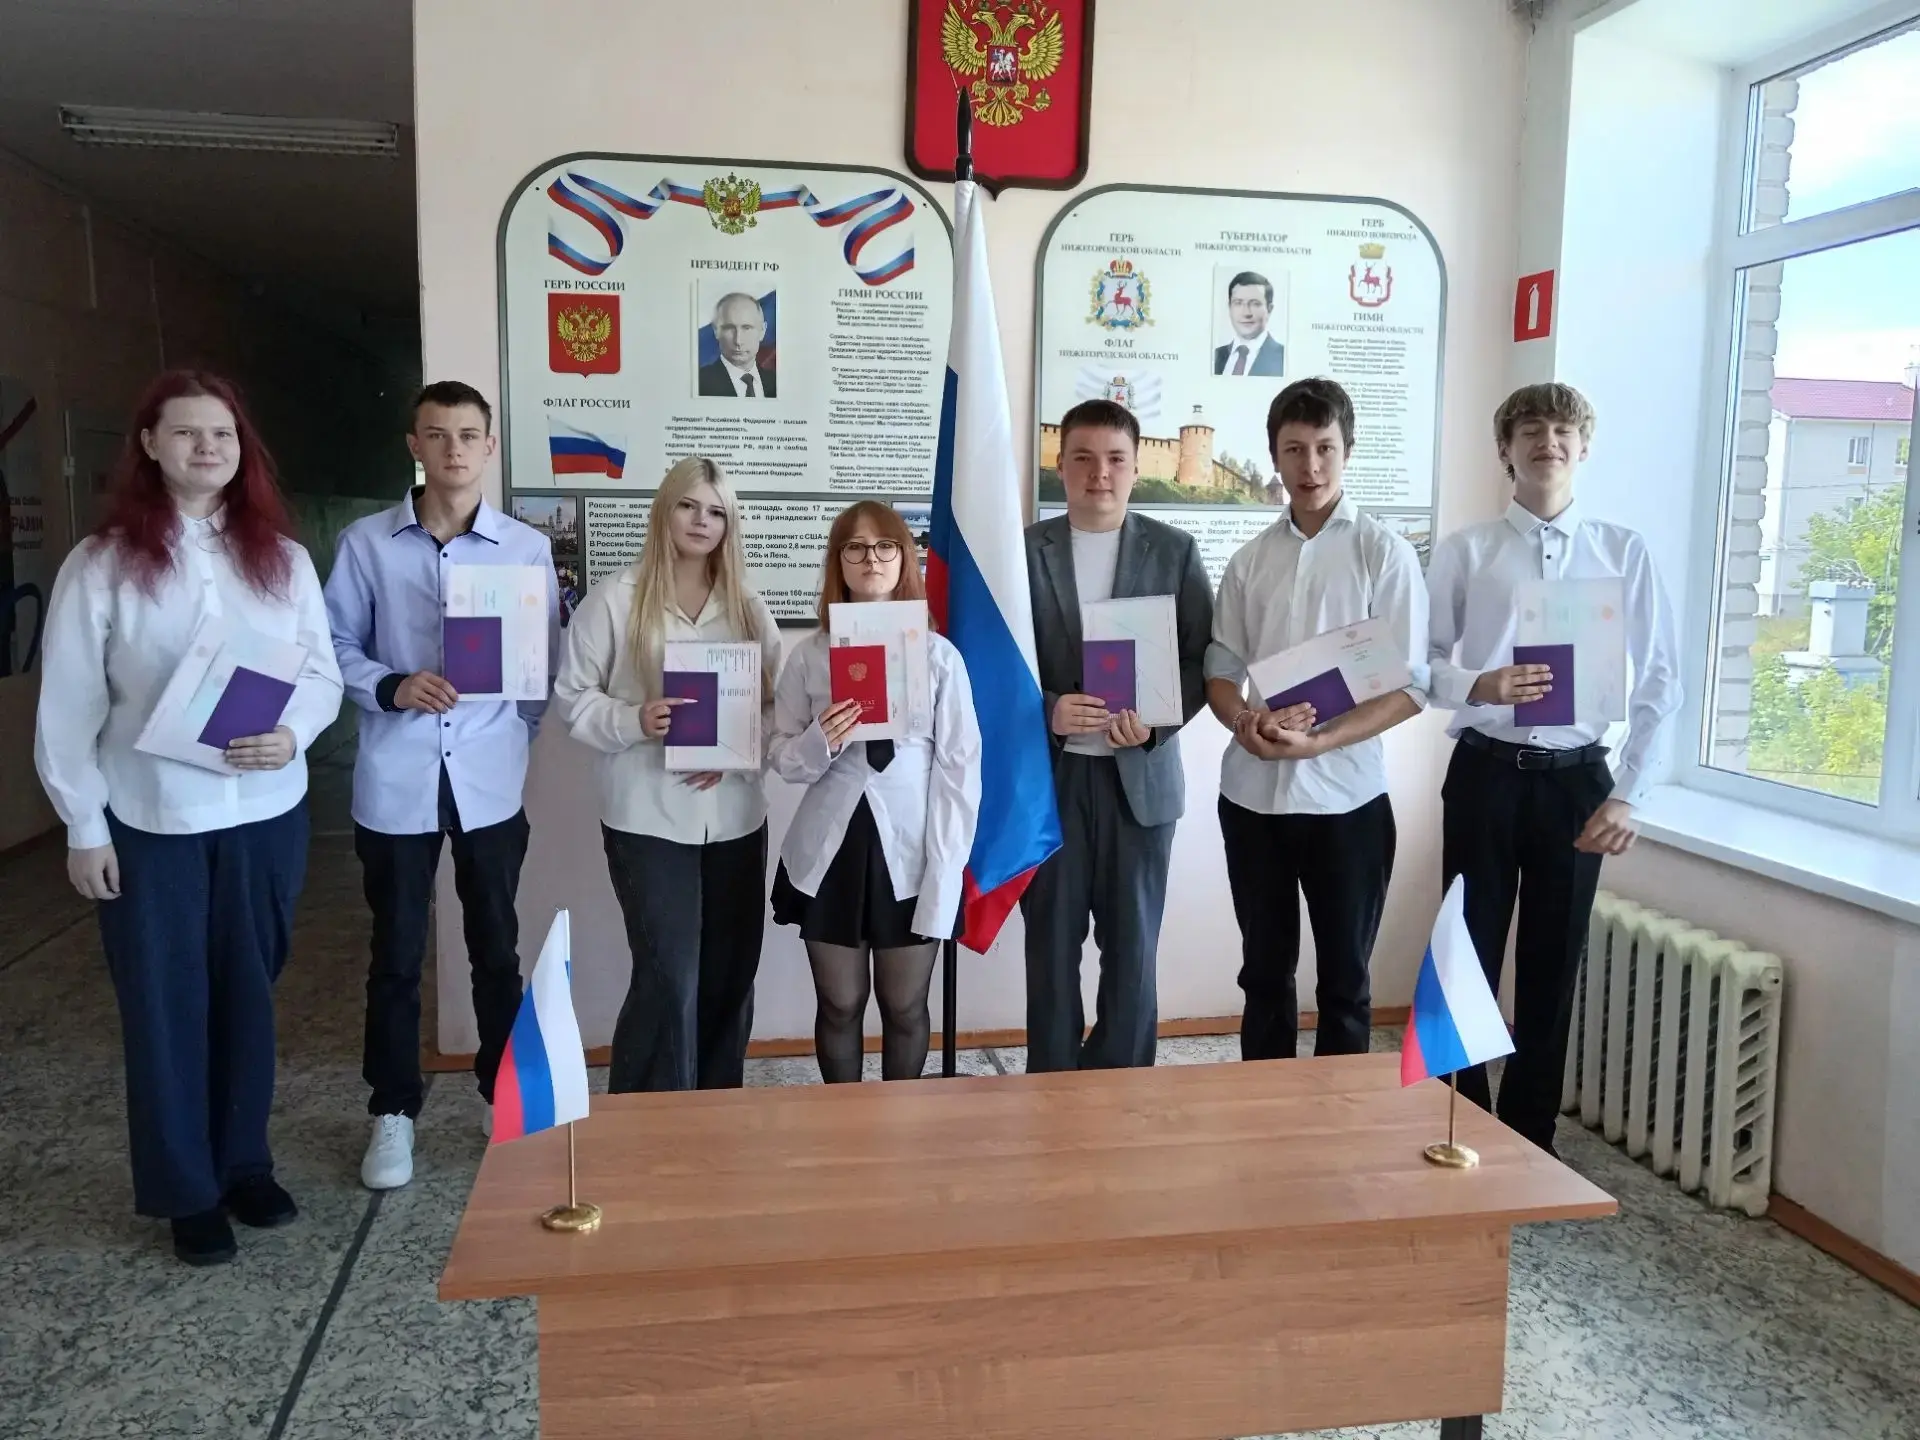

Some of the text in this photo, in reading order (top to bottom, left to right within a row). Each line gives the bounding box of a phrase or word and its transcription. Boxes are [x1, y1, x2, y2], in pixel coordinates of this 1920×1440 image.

[1362, 219, 1384, 228] ГЕРБ
[1110, 233, 1134, 242] ГЕРБ
[1220, 231, 1288, 242] ГУБЕРНАТОР
[1061, 244, 1181, 256] НИЖЕГОРОДСКОЙ ОБЛАСТИ
[1195, 243, 1312, 255] НИЖЕГОРОДСКОЙ ОБЛАСТИ
[691, 259, 779, 272] ПРЕЗИДЕНТ РФ
[544, 279, 625, 291] ГЕРБ РОССИИ
[839, 288, 923, 300] ГИМН РОССИИ
[1354, 313, 1383, 321] ГИМН
[1104, 339, 1134, 347] ФЛАГ
[1059, 349, 1137, 359] НИЖЕГОРОДСКОЙ
[543, 398, 631, 408] ФЛАГ РОССИИ
